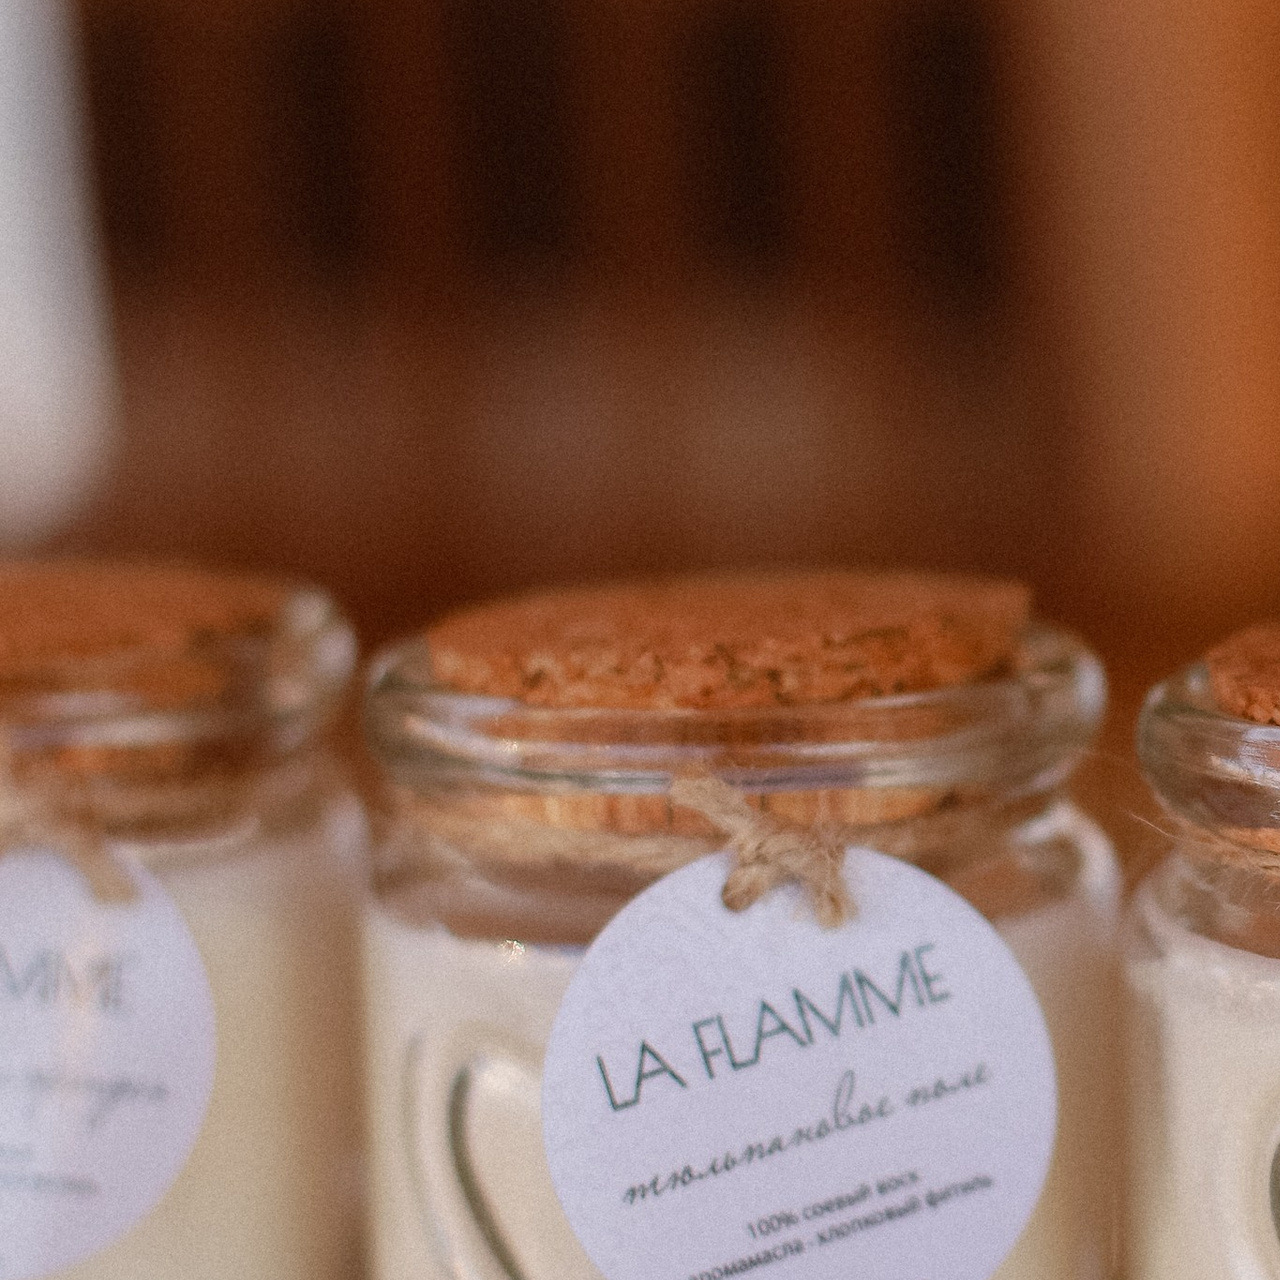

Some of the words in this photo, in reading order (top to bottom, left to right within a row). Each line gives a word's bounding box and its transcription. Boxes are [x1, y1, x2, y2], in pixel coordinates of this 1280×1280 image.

[596, 1039, 687, 1112] LA
[692, 943, 951, 1080] FLAMME
[747, 1209, 799, 1239] 100%
[802, 1183, 871, 1221] соевый
